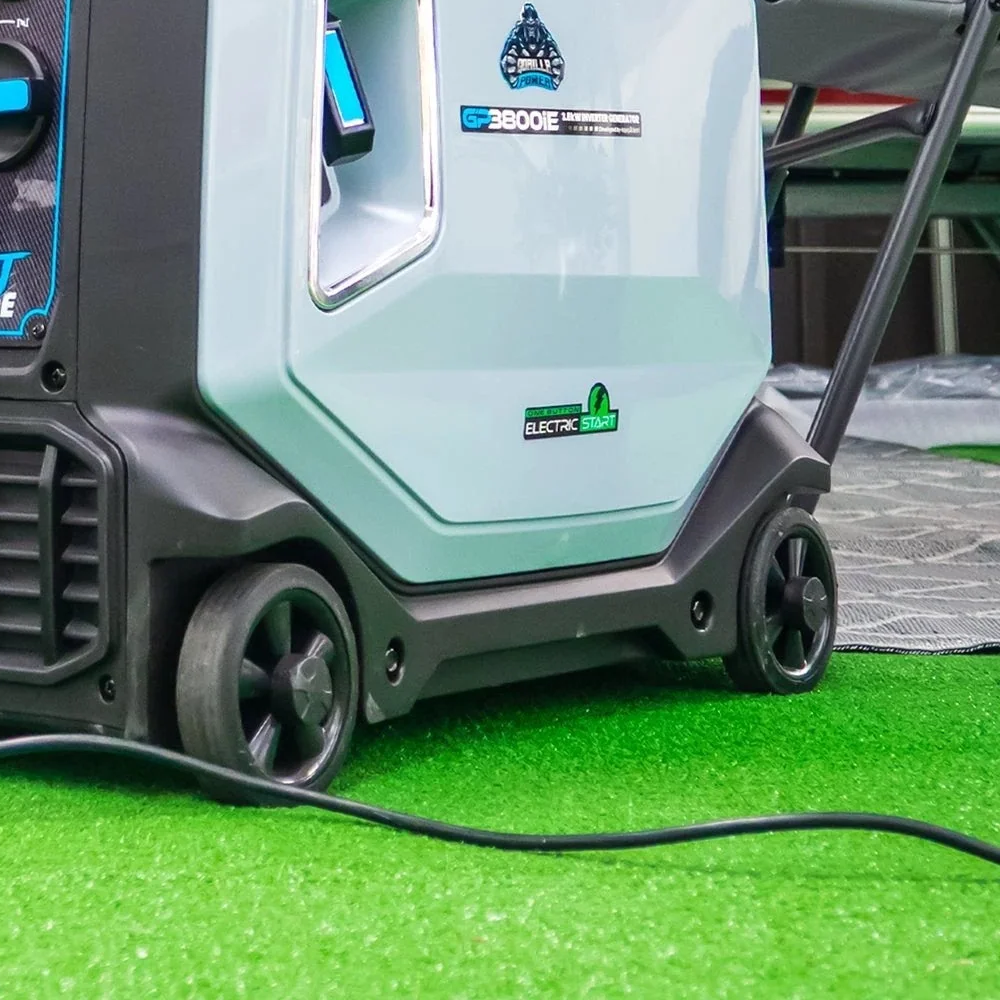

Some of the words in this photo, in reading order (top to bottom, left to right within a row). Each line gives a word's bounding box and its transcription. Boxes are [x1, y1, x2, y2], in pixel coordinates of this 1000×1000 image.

[527, 408, 544, 417] ONE
[547, 405, 579, 415] BUTTON
[525, 417, 579, 436] ELECTRIC
[581, 414, 616, 431] START
